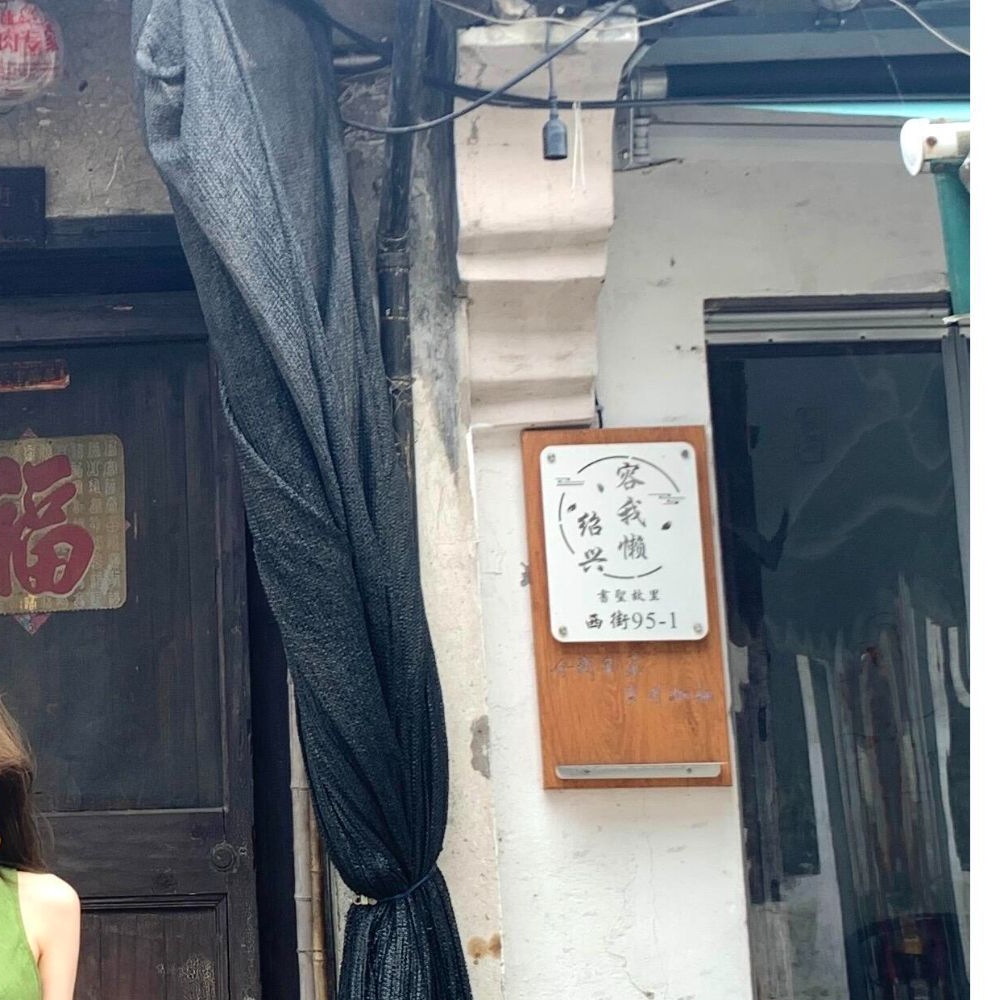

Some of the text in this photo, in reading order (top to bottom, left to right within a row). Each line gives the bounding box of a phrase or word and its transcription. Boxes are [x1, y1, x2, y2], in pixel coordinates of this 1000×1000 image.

[577, 510, 608, 573] 绍兴
[616, 461, 648, 561] 容我懒
[585, 610, 679, 631] 西街95-1
